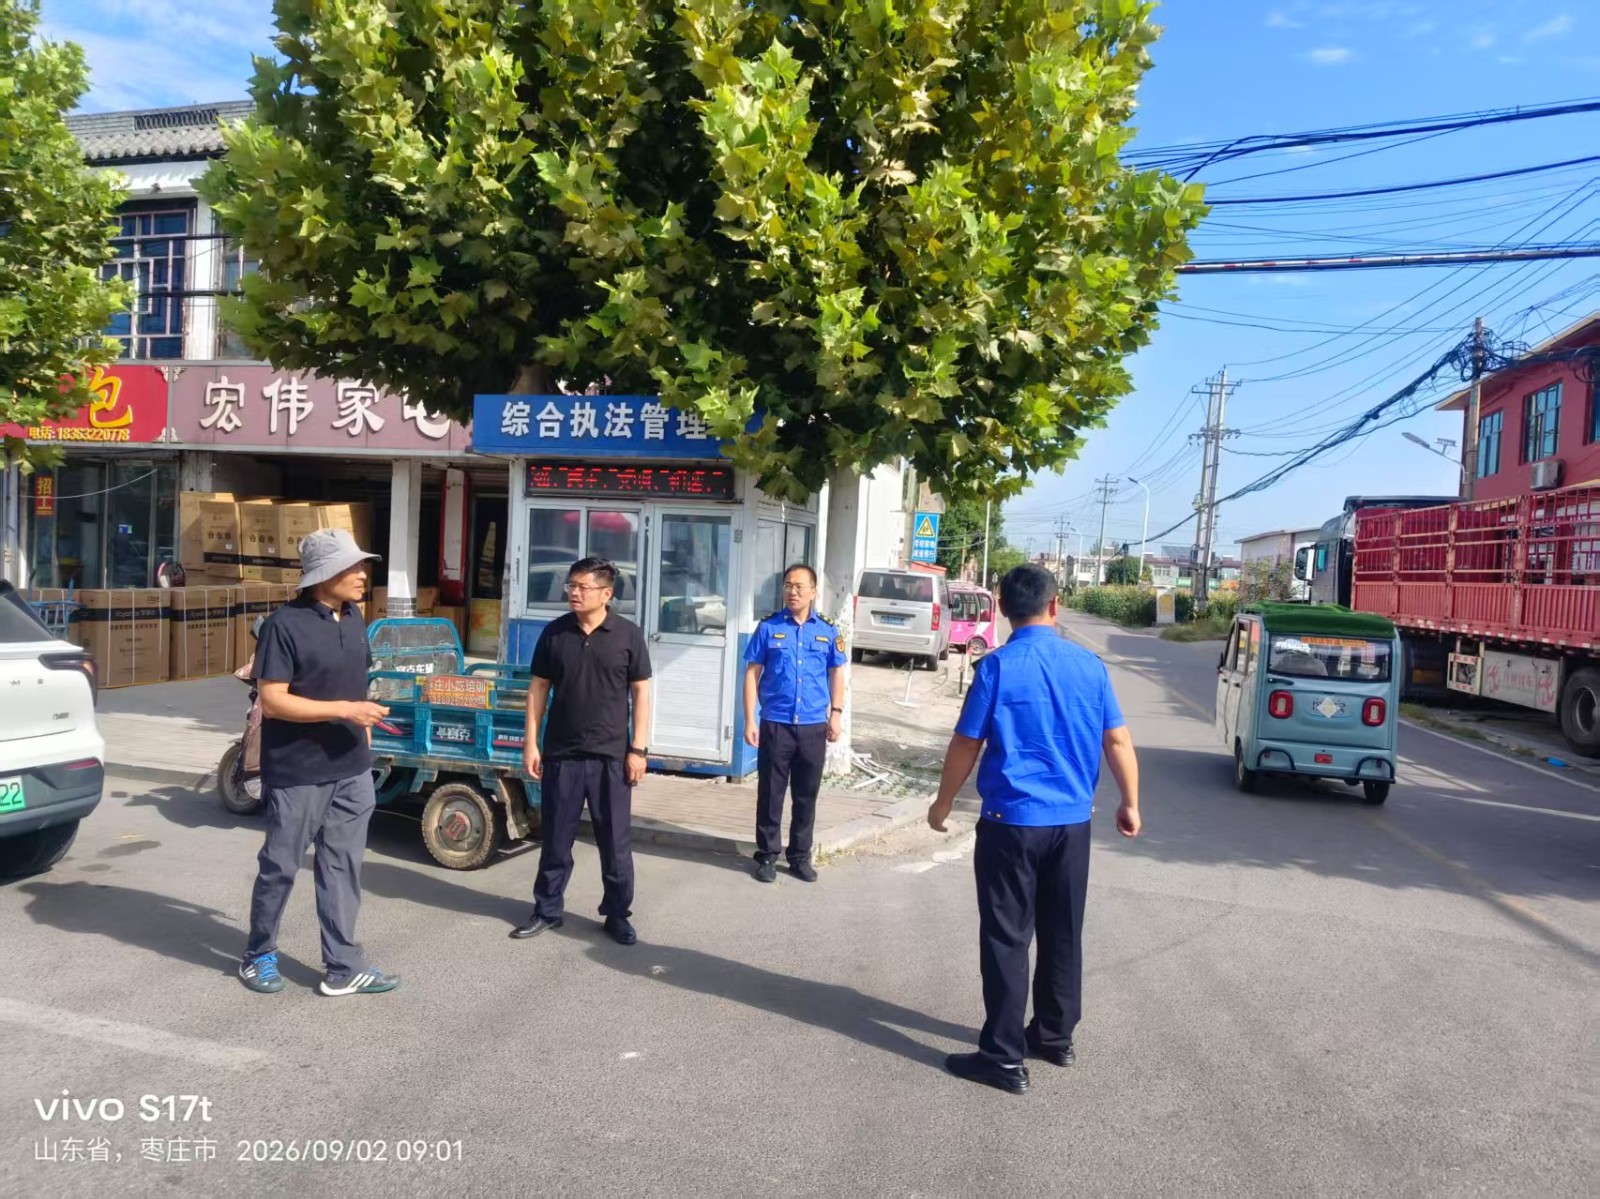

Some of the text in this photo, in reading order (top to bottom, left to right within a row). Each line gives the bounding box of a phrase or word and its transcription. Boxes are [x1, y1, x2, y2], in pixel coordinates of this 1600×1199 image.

[501, 401, 723, 440] 综合执法管理
[37, 476, 52, 510] 招工
[429, 679, 486, 693] 庄小吃培训
